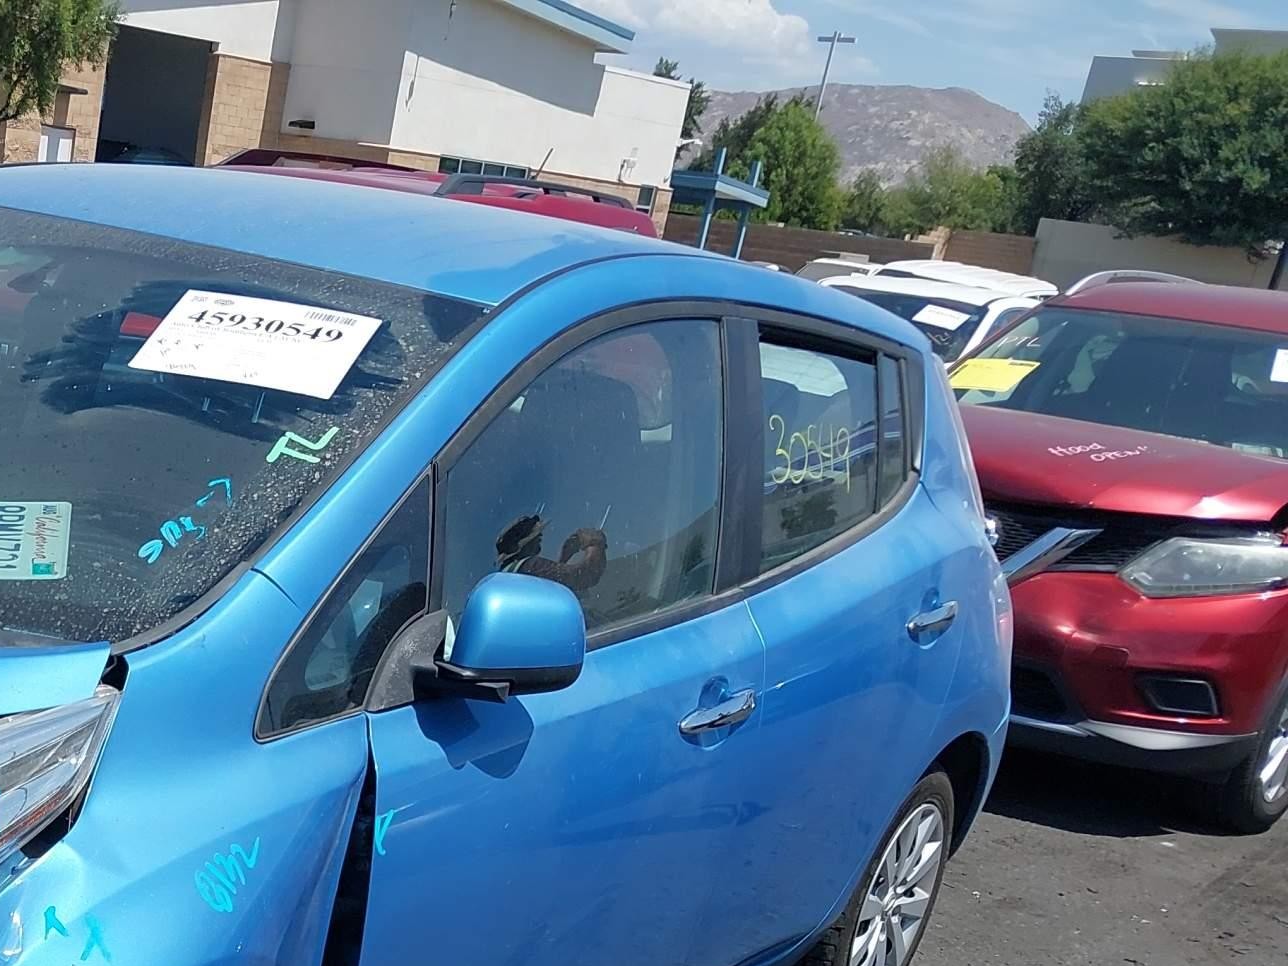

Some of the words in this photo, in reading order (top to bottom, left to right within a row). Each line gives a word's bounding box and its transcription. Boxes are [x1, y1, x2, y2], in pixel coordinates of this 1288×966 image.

[188, 309, 344, 343] 45930549
[266, 426, 340, 463] TL
[769, 414, 850, 494] 30549
[25, 516, 61, 560] California
